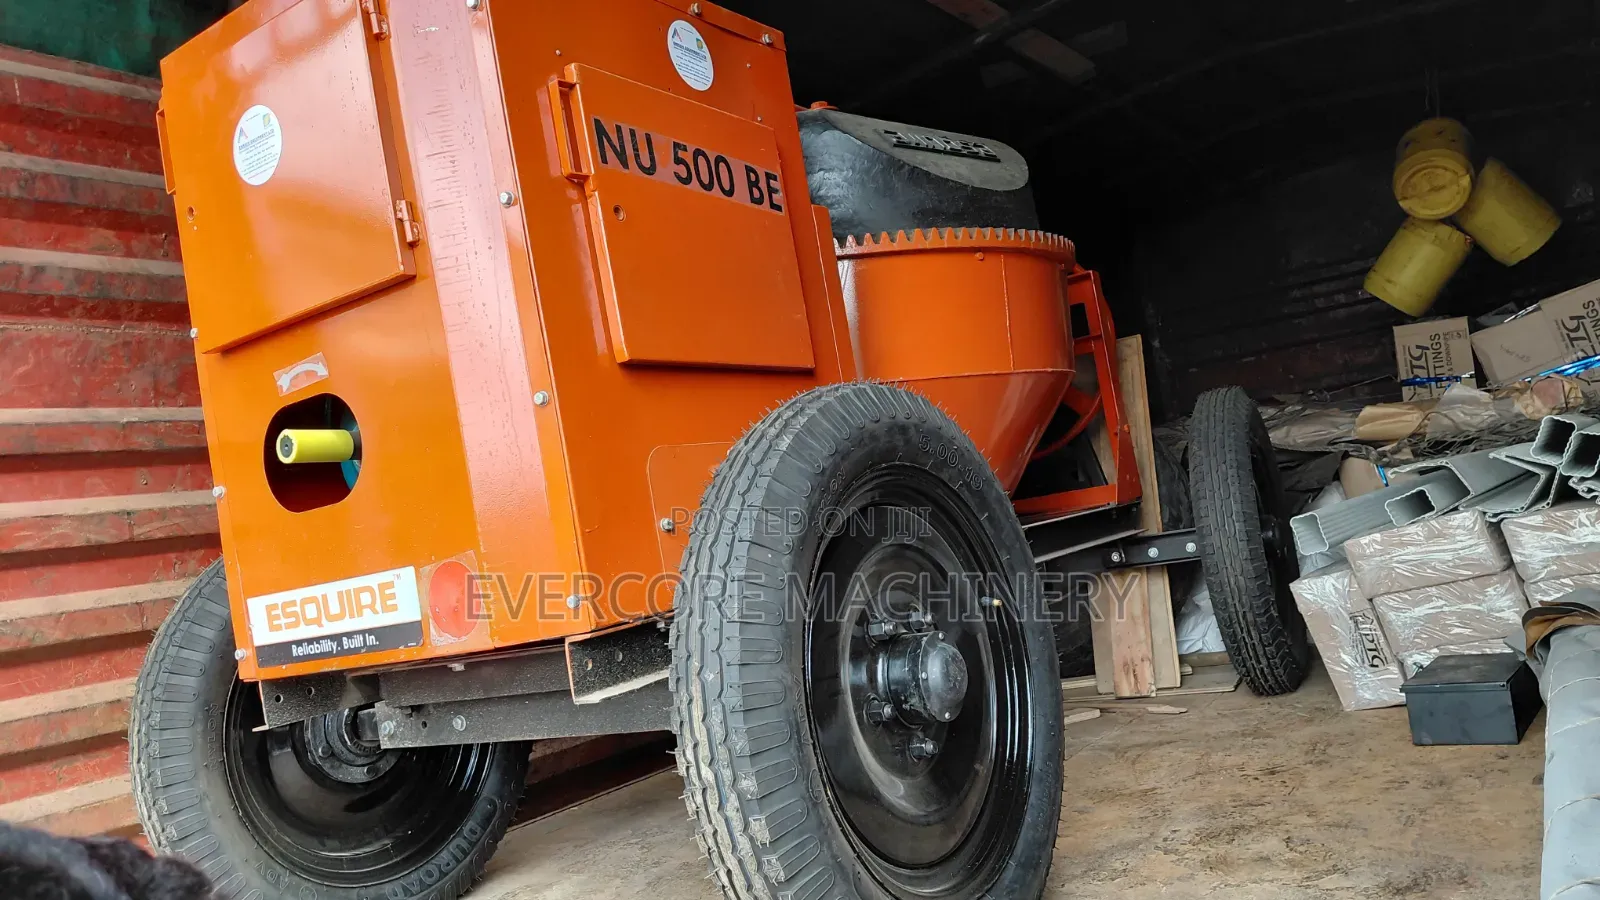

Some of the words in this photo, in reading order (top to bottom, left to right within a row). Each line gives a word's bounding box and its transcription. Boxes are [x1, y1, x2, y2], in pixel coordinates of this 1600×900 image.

[594, 118, 656, 176] NU
[672, 141, 735, 198] 500
[744, 165, 783, 213] BE
[1430, 333, 1446, 389] FTTINGS
[265, 580, 399, 633] ESQUIRE
[291, 639, 341, 658] Reliability.
[342, 634, 365, 650] Built
[365, 633, 380, 647] In.
